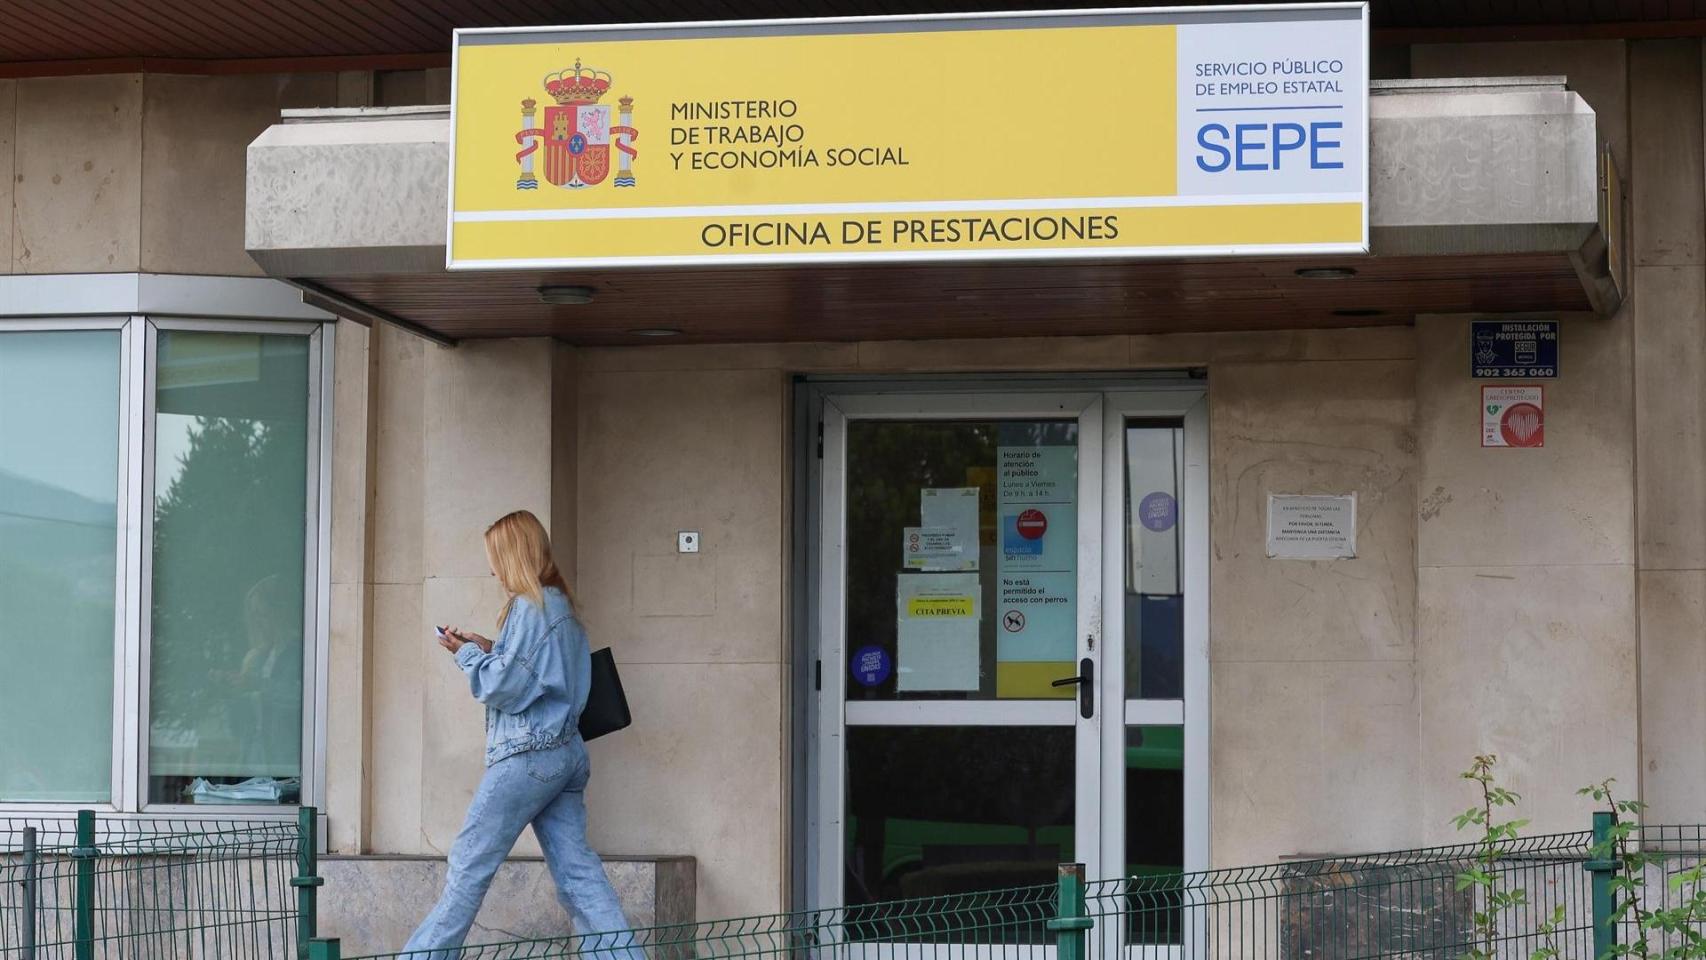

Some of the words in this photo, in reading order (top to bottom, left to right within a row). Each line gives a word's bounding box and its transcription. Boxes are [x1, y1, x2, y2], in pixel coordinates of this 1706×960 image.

[1195, 61, 1267, 77] SERVICIO
[1272, 57, 1343, 75] PÚBLICO
[1195, 83, 1216, 96] DE
[1219, 81, 1278, 95] EMPLEO
[1283, 80, 1343, 94] ESTATAL
[671, 99, 797, 121] MINISTERIO
[671, 127, 699, 145] DE
[704, 125, 804, 148] TRABAJO
[1196, 121, 1344, 173] SEPE
[670, 152, 681, 170] Y
[692, 145, 819, 170] ECONOMÍA
[826, 147, 909, 167] SOCIAL
[701, 221, 830, 248] OFICINA
[842, 220, 881, 245] DE
[893, 215, 1118, 244] PRESTACIONES
[1540, 332, 1556, 340] POR
[1476, 368, 1500, 377] 902
[1503, 368, 1526, 377] 365
[1529, 368, 1554, 377] 060
[1003, 587, 1036, 595] permitido
[915, 607, 934, 616] CITA
[936, 607, 966, 616] PREVIA
